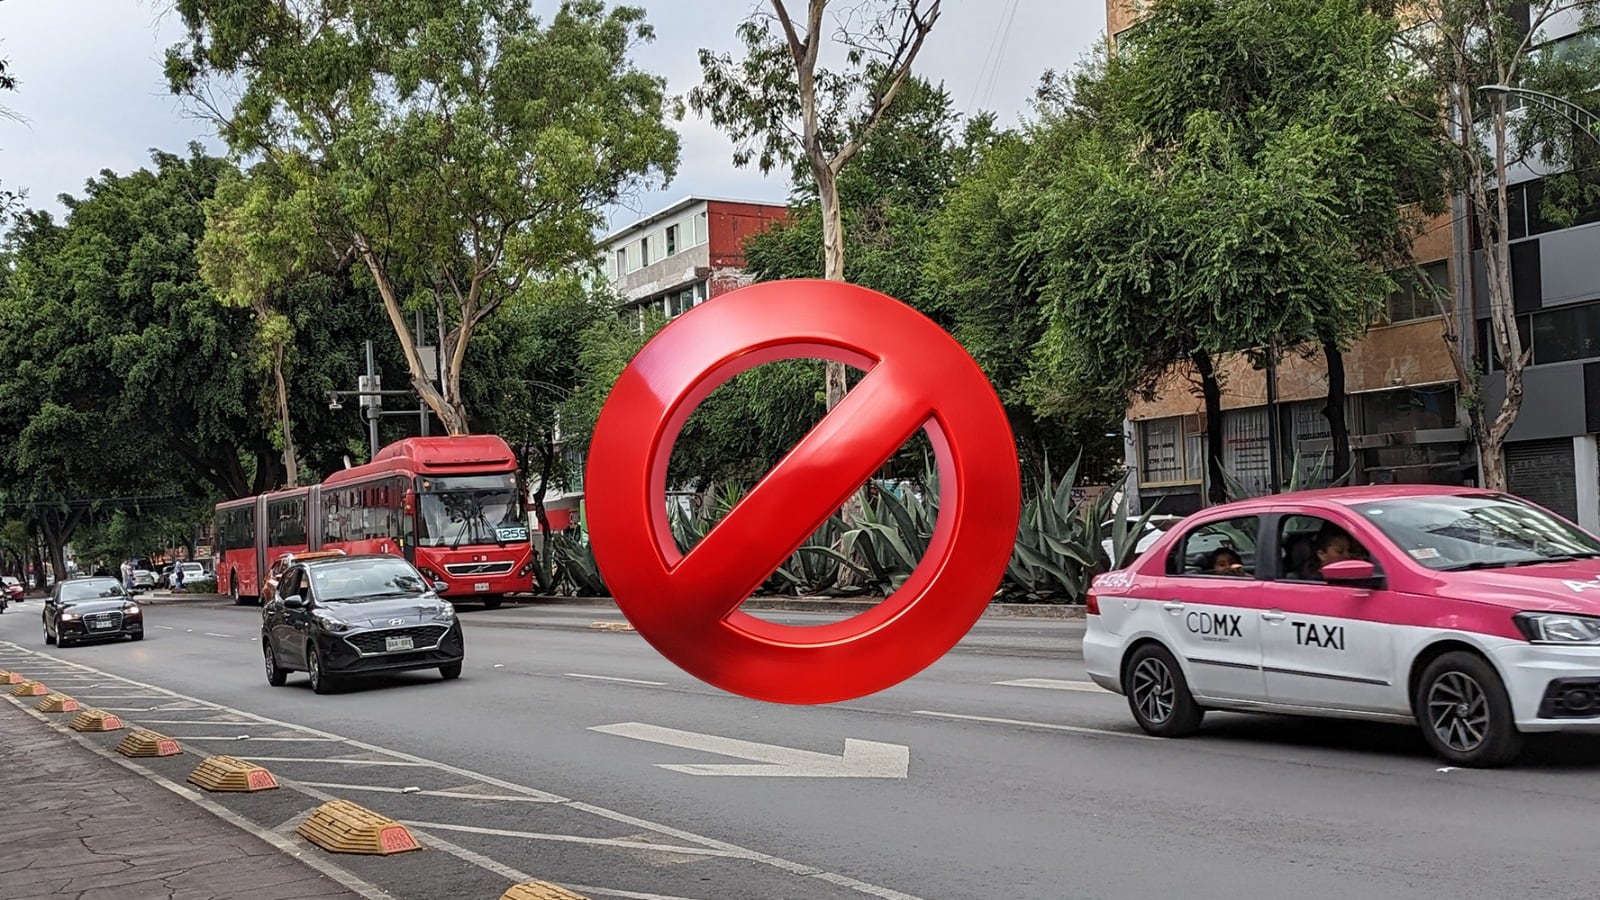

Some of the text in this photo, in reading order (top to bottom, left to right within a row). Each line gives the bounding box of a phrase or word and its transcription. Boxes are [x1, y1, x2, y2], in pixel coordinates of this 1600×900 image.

[498, 529, 527, 539] 1259
[1186, 611, 1243, 638] CDMX
[1291, 621, 1345, 650] TAXI
